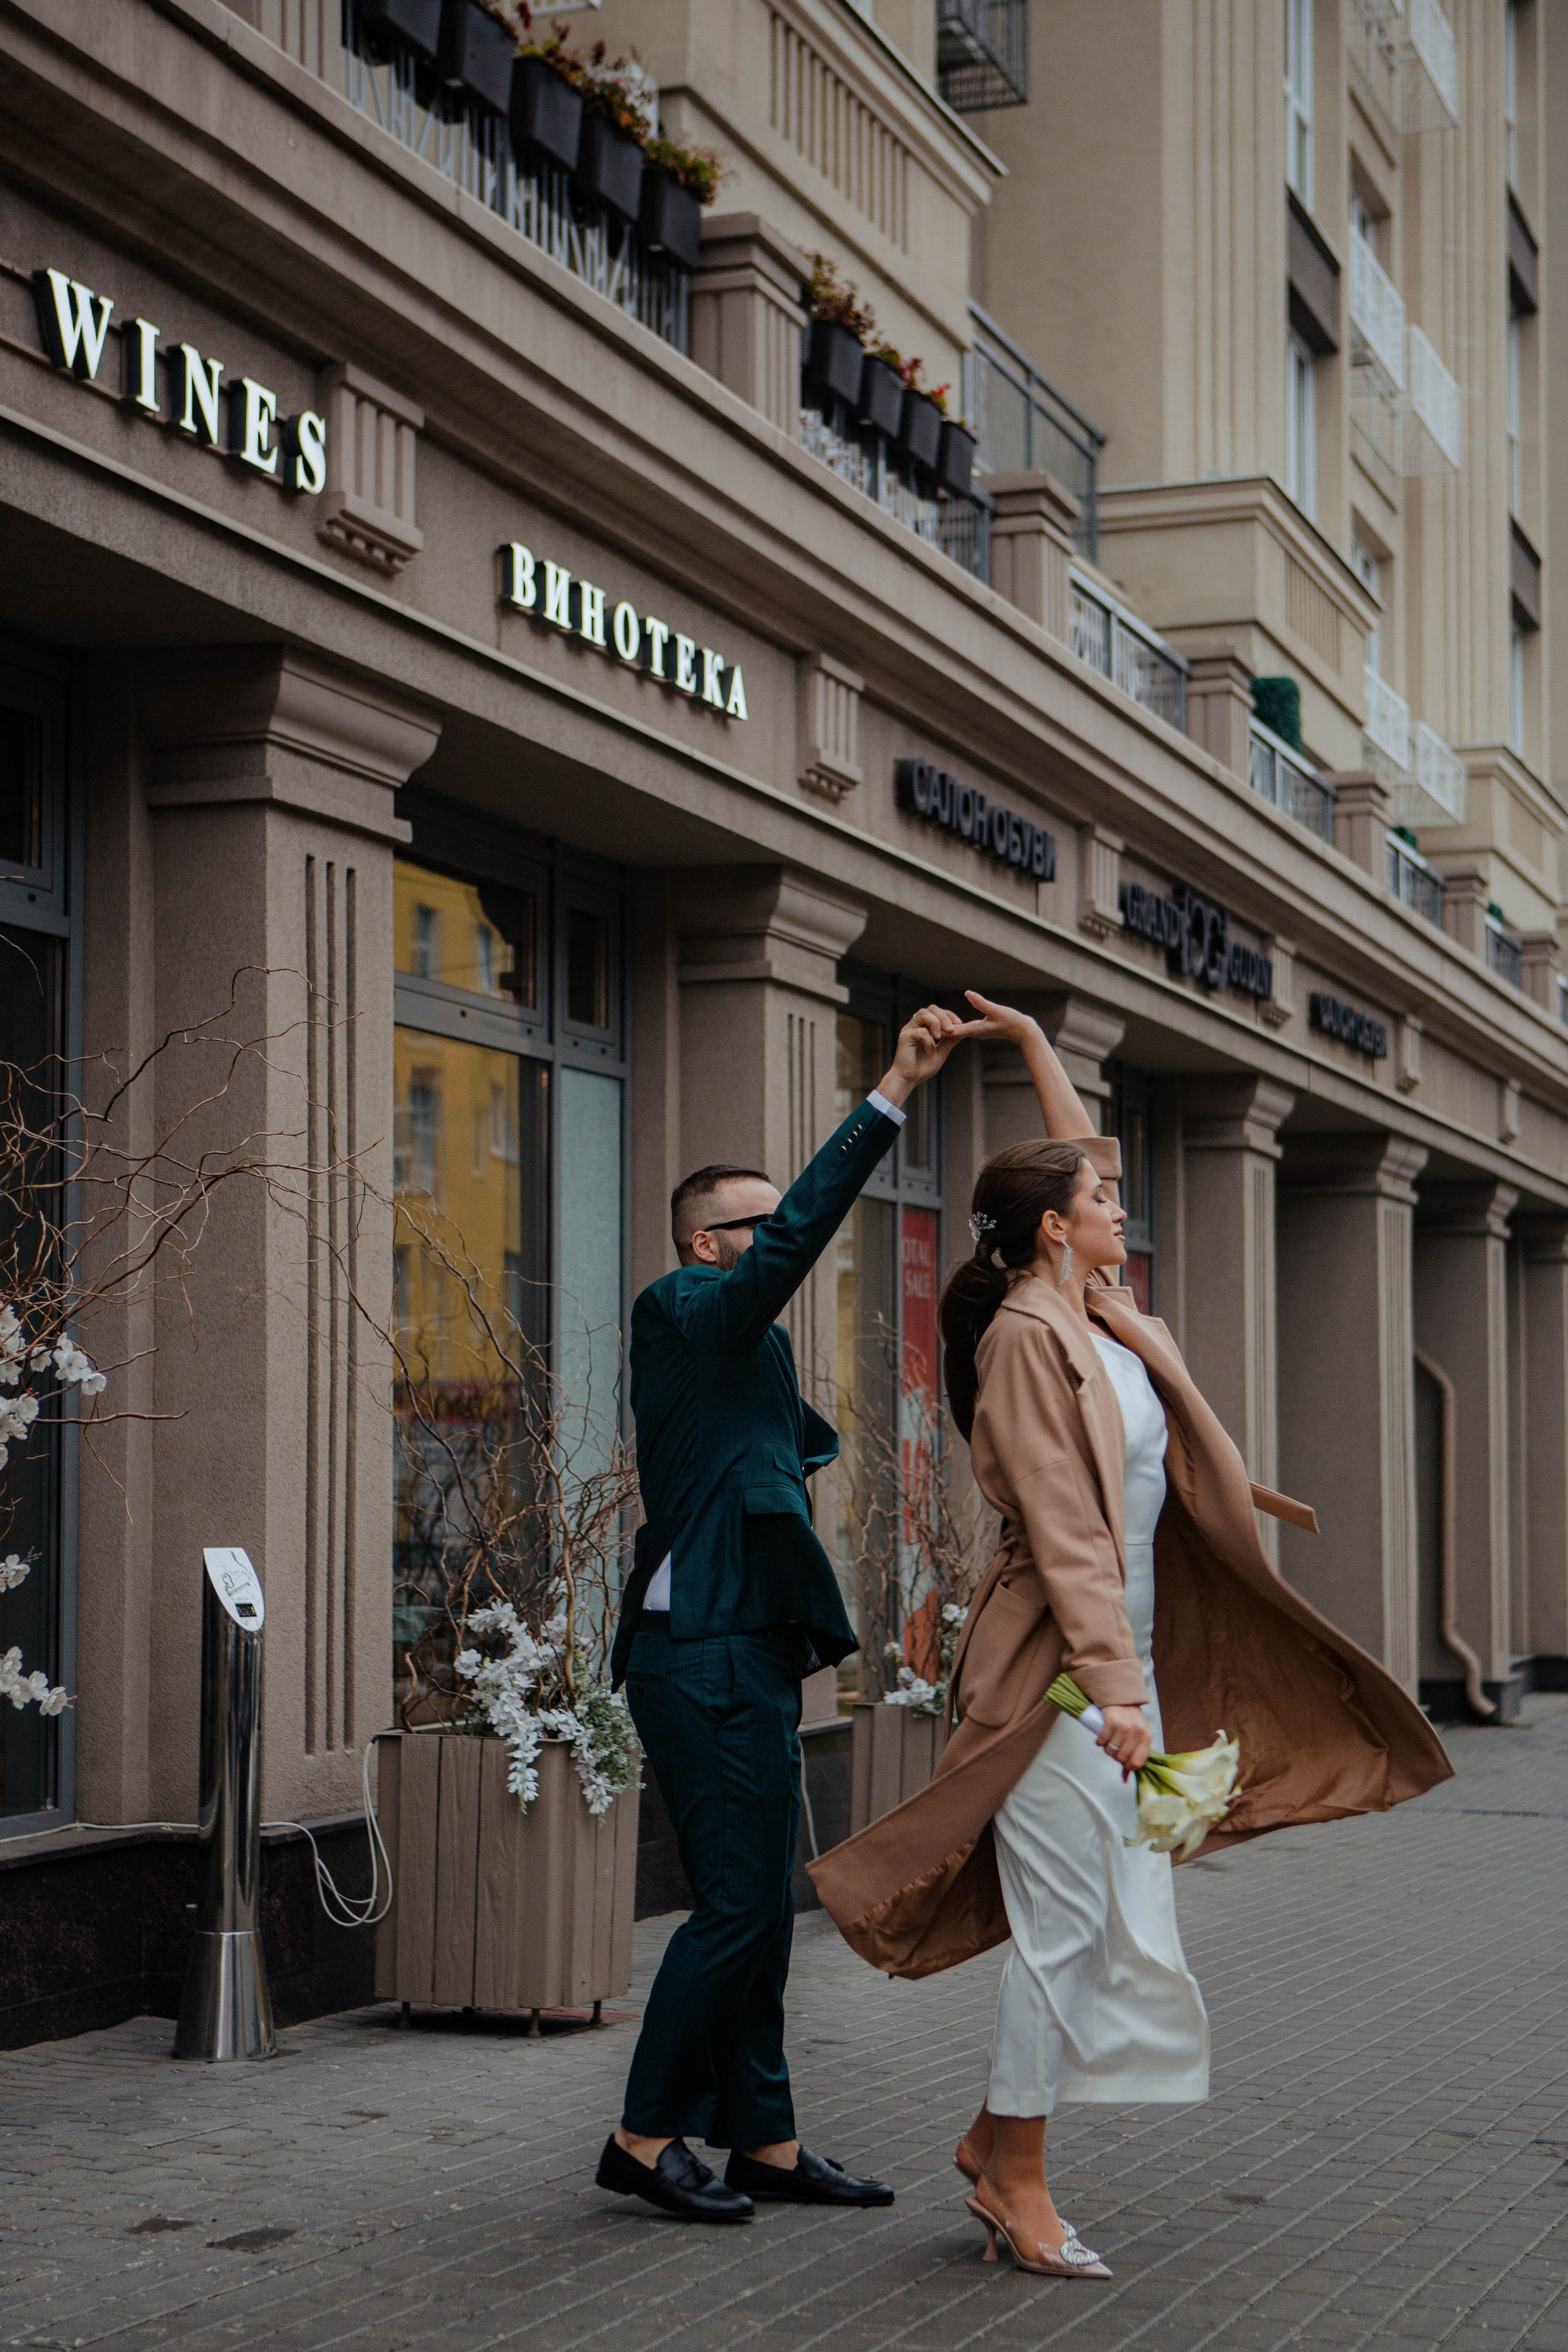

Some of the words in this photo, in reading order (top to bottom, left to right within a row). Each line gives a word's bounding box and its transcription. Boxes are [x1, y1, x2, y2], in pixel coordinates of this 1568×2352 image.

[47, 267, 326, 495] WINES
[510, 541, 749, 722] ВИНОТЕКА
[913, 758, 988, 846] САЛОН
[993, 805, 1056, 880] ОБУВИ
[905, 1269, 930, 1299] SALE
